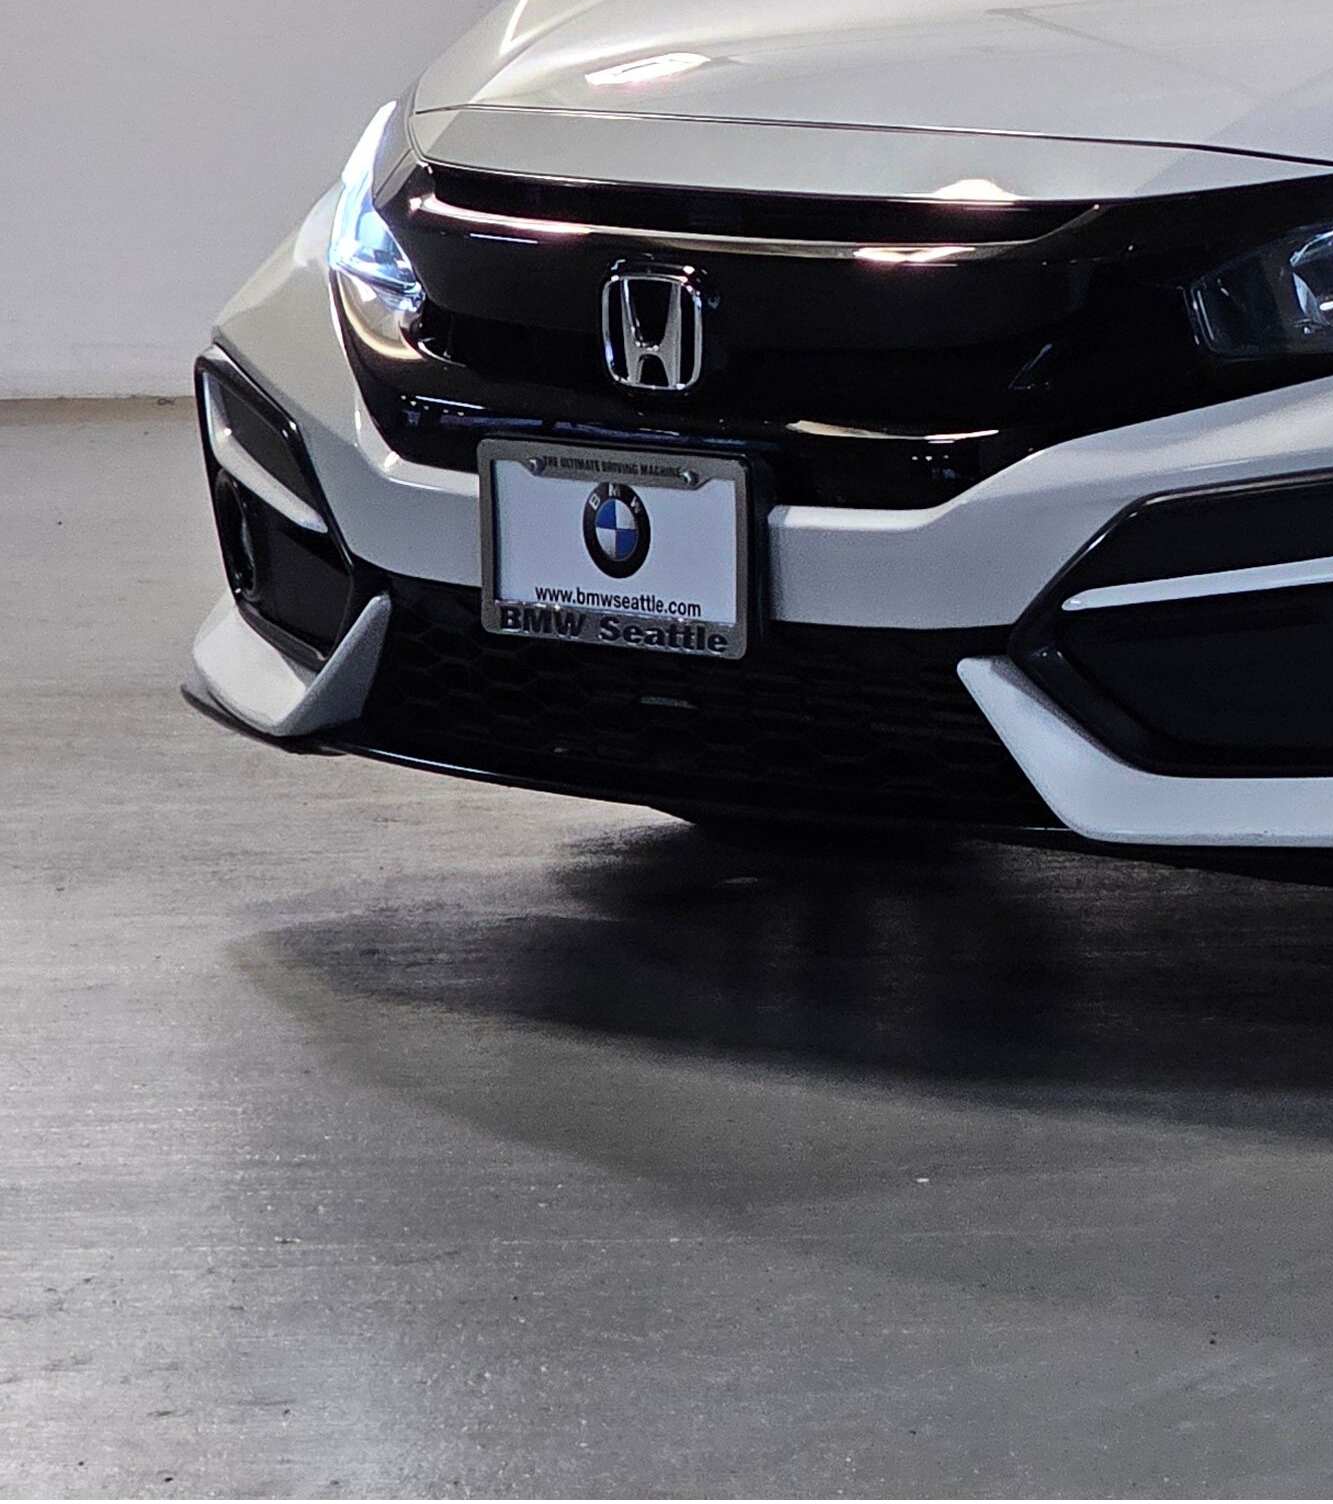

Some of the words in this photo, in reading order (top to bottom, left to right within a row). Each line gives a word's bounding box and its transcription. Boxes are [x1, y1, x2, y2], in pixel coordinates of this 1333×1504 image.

[589, 482, 641, 513] BMW
[535, 586, 702, 618] www.bmwseattle.com
[500, 605, 586, 638] BMW
[598, 615, 729, 653] Seattle
